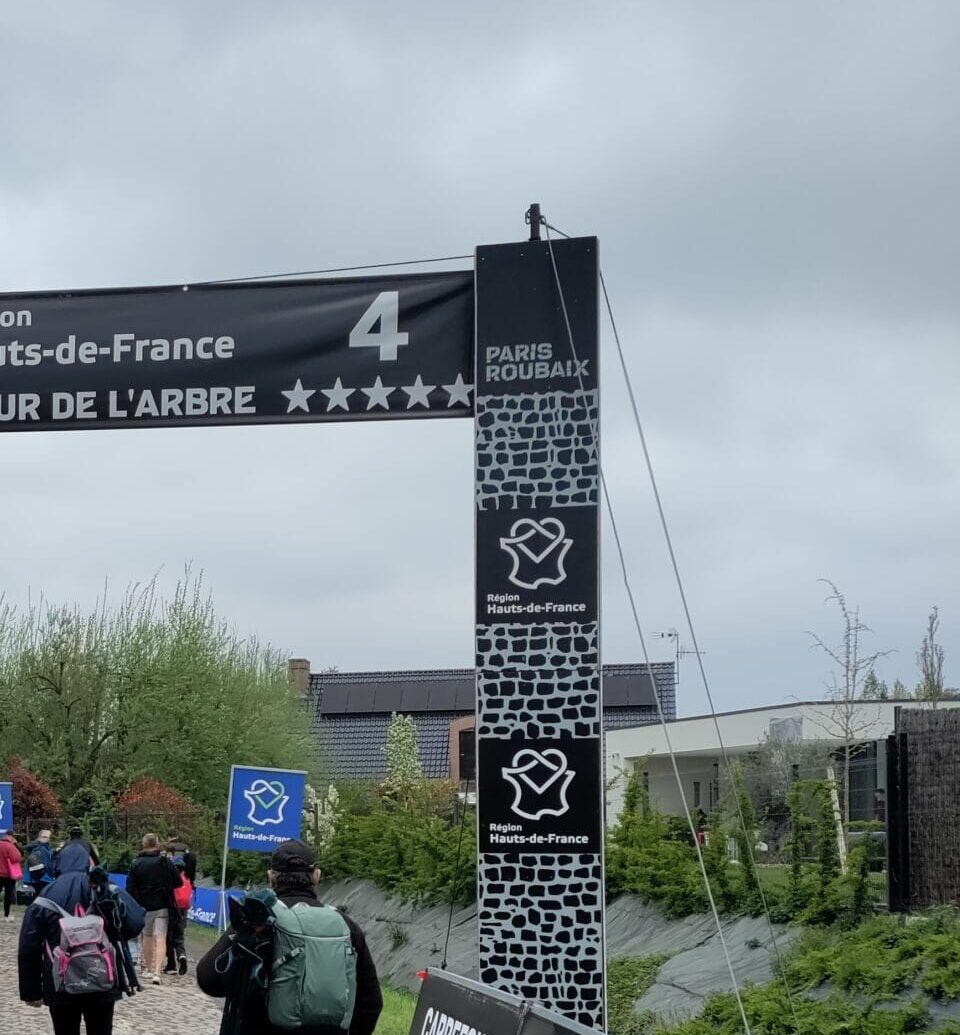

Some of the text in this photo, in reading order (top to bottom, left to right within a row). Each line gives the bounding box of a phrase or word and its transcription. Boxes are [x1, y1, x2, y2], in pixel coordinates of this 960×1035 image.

[348, 290, 409, 361] 4
[486, 342, 553, 364] PARIS
[485, 359, 590, 383] ROUBAIX
[52, 392, 98, 420] DE
[109, 386, 256, 418] L'ARBRE
[486, 593, 520, 605] Région
[487, 602, 586, 614] Hauts-de-France
[489, 823, 522, 835] Région
[489, 832, 589, 844] Hauts-de-France
